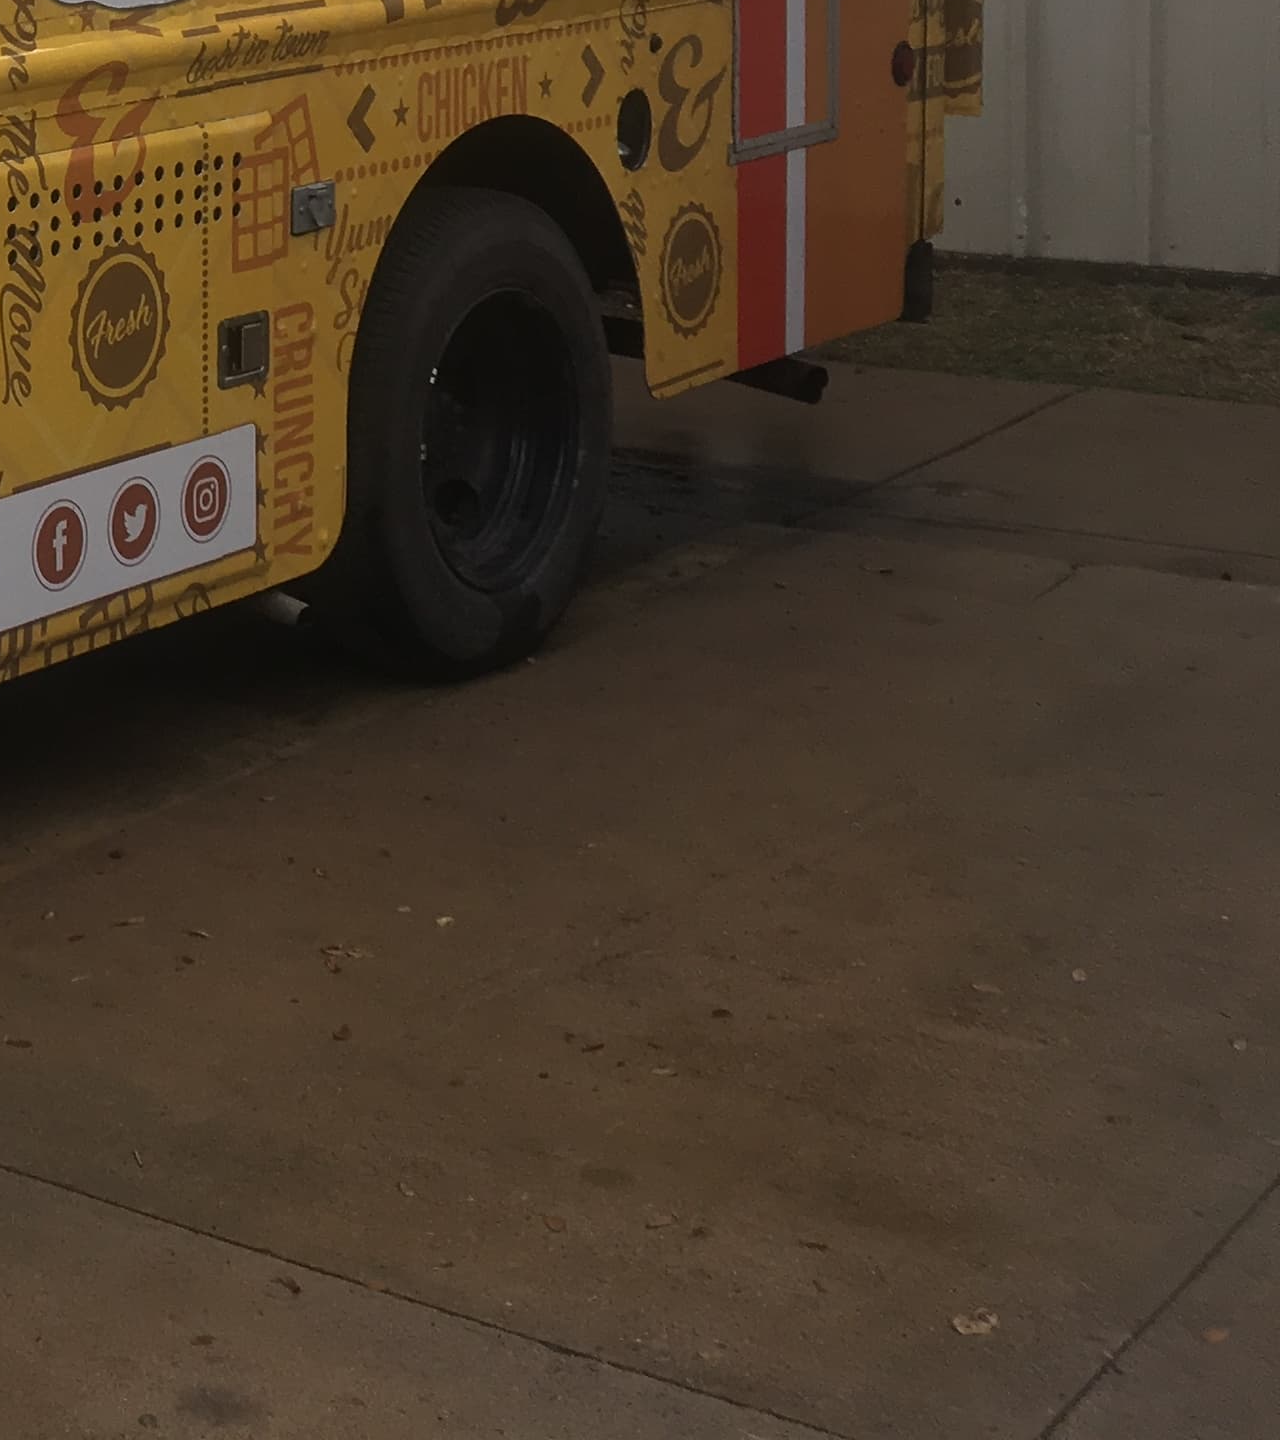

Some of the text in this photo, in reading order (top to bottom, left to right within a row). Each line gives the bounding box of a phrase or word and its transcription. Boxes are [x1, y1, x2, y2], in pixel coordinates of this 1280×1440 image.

[186, 25, 252, 85] best
[270, 18, 331, 63] town
[416, 54, 532, 144] CHICKEN
[85, 292, 154, 360] Fresh
[273, 301, 315, 557] CRUNCHY
